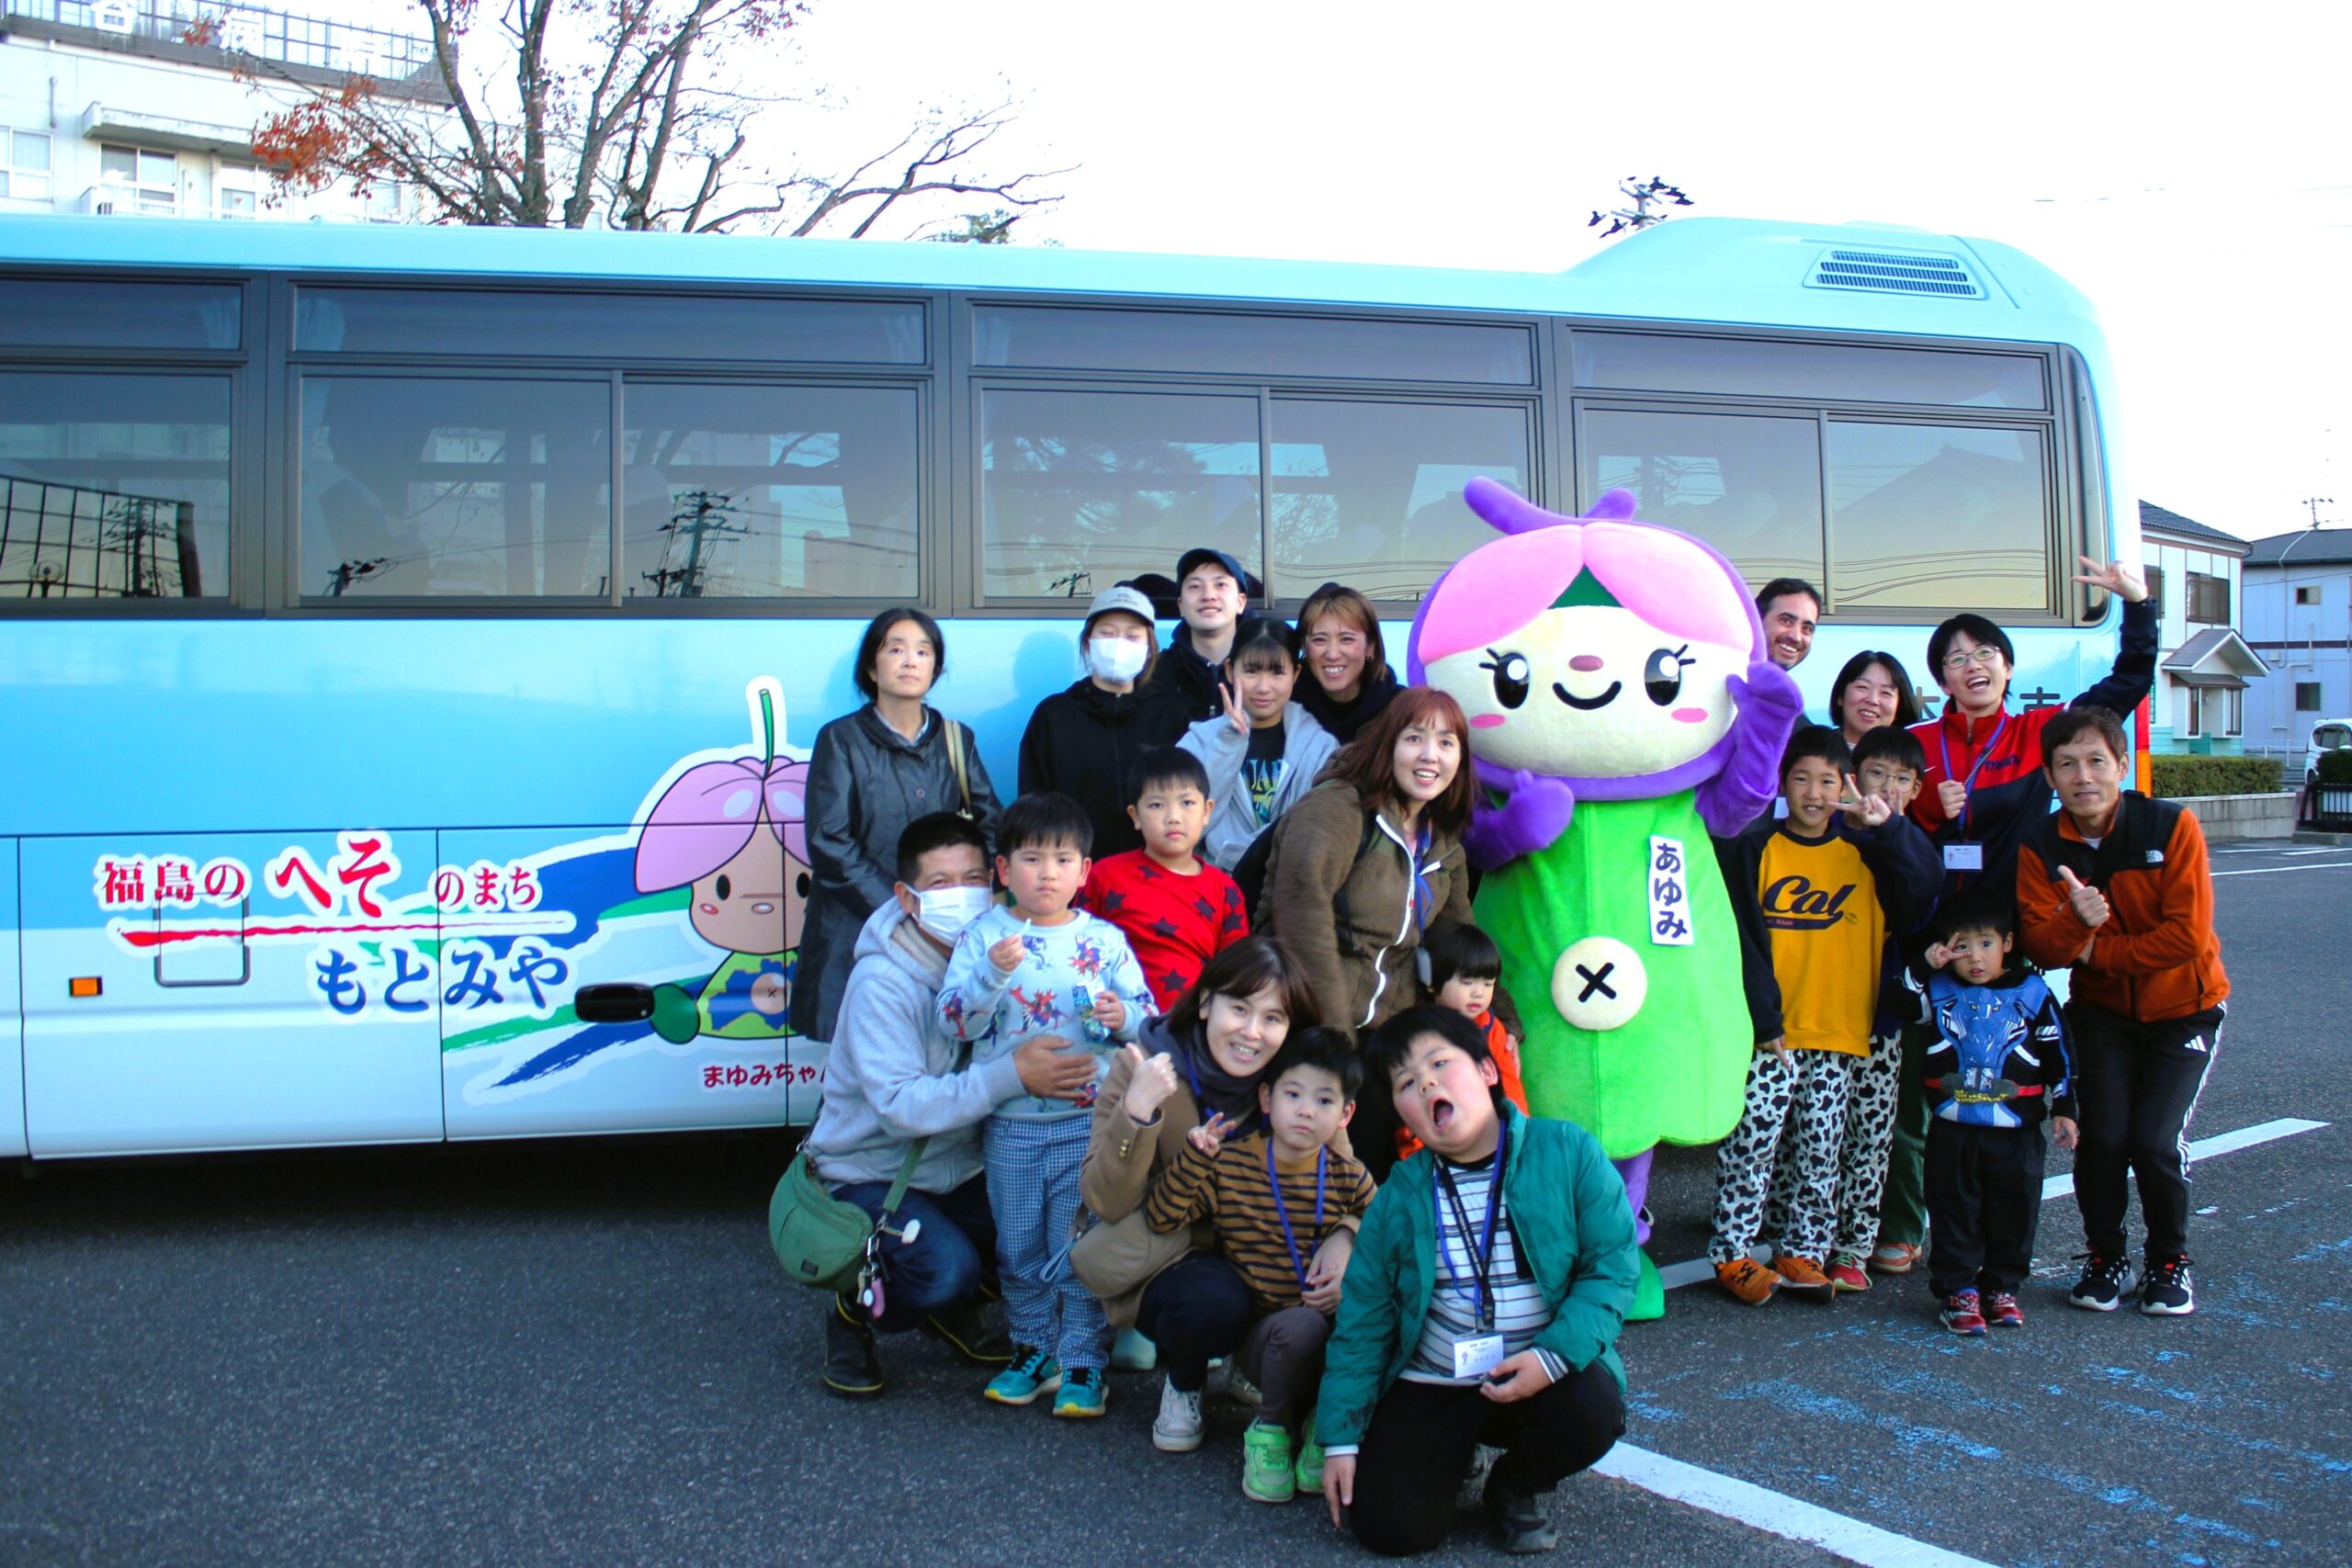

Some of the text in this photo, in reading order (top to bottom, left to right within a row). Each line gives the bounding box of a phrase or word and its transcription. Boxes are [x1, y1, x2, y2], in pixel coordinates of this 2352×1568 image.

[102, 838, 537, 919] 福島のへそのまち
[1655, 842, 1688, 939] あゆみ
[1763, 874, 1857, 917] Cal
[315, 945, 568, 1011] もとみや
